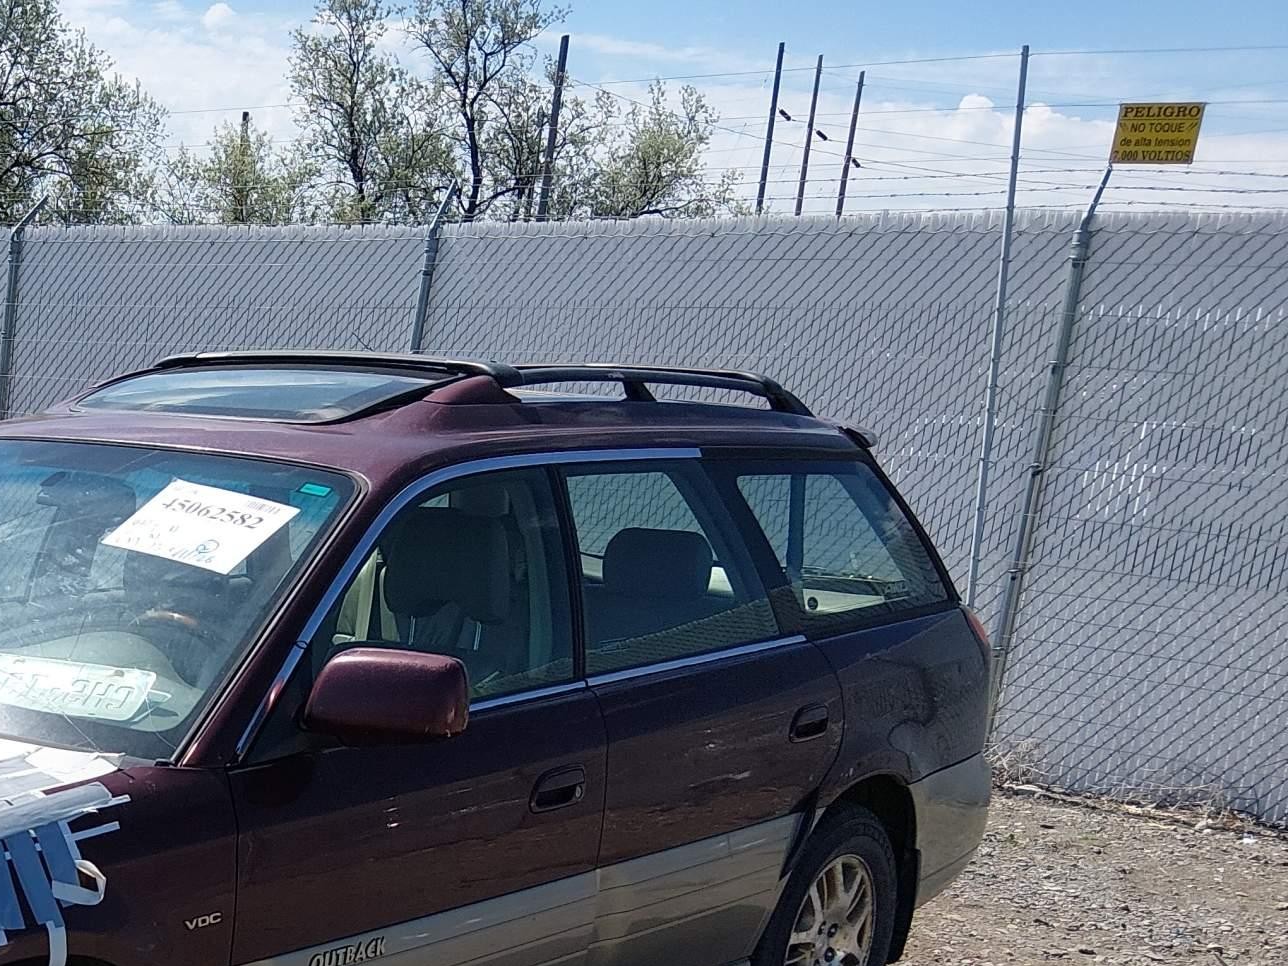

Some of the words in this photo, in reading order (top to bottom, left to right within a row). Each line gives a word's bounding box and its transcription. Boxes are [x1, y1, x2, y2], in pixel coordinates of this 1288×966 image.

[1123, 106, 1201, 118] PELIGRO
[1130, 123, 1146, 133] NO
[1119, 137, 1133, 147] de
[1134, 137, 1152, 147] alta
[1141, 150, 1191, 161] VOLTIOS
[162, 498, 265, 530] 45062582
[185, 912, 222, 930] VDC
